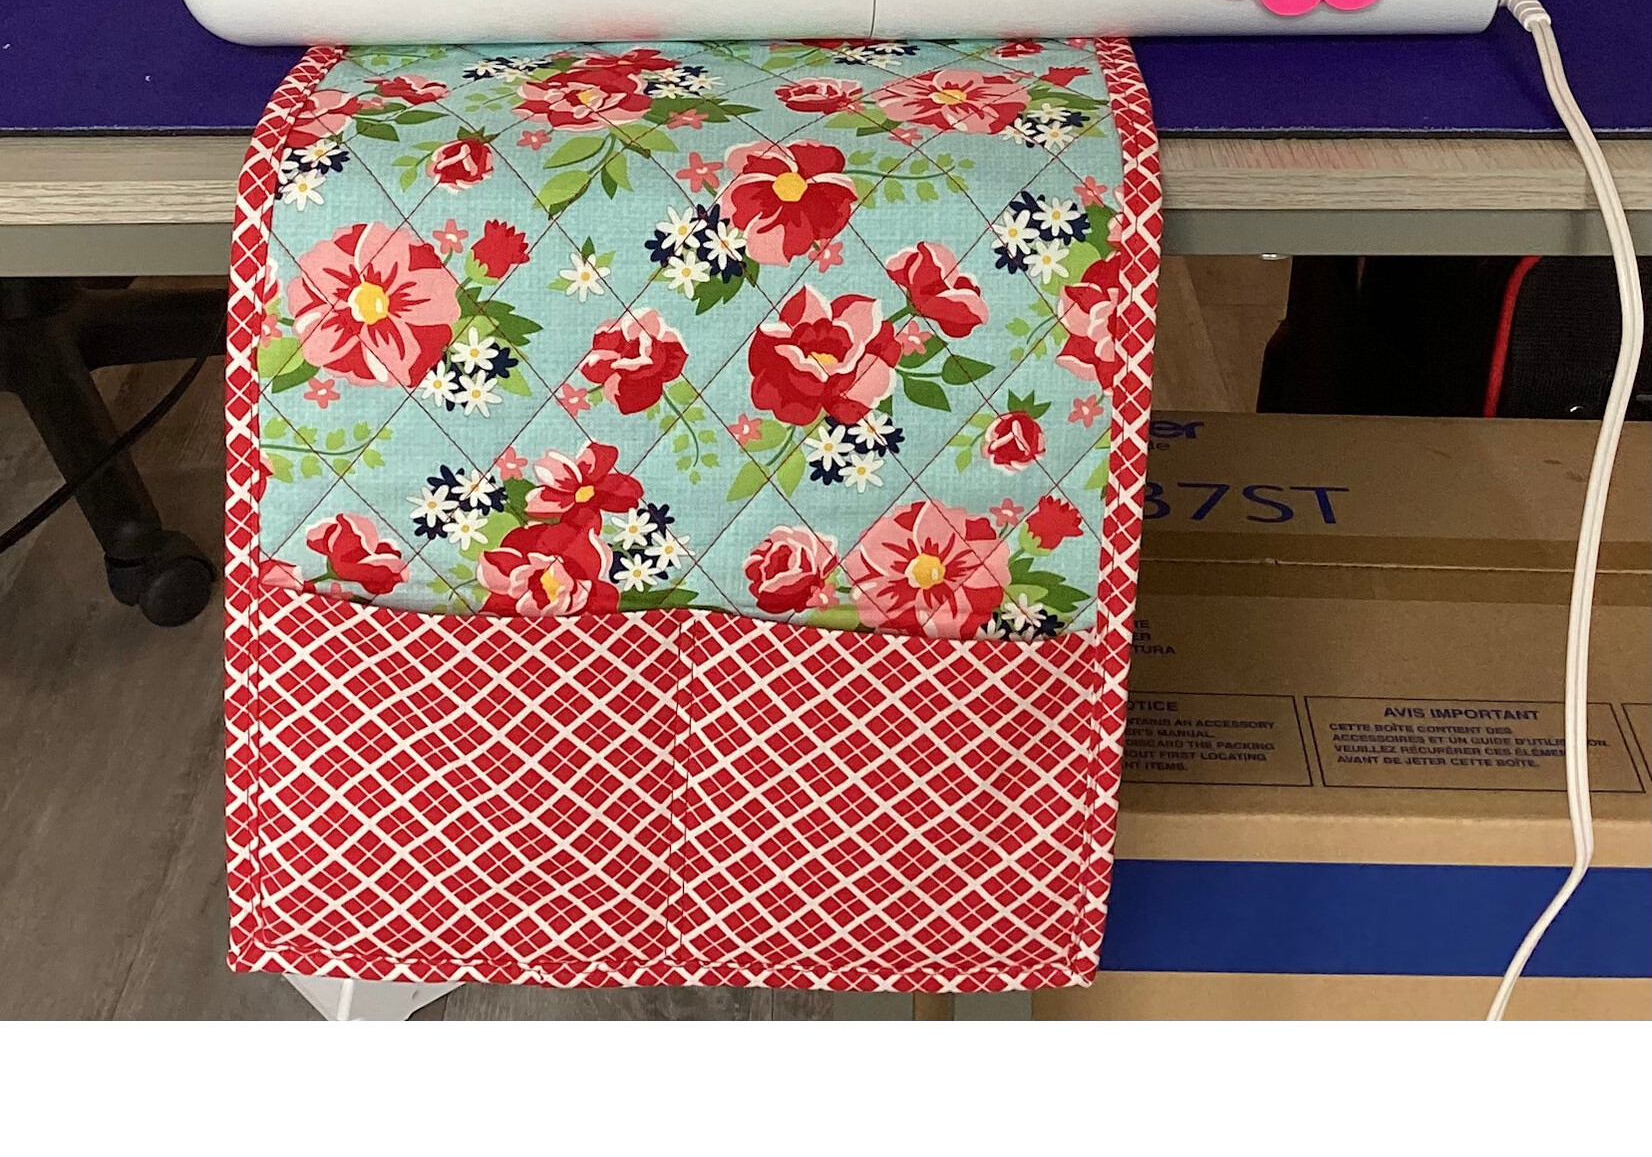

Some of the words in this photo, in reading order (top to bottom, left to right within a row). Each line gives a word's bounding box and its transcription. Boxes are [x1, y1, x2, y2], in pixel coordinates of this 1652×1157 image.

[1384, 707, 1425, 719] AVIS
[1431, 708, 1540, 720] IMPORTANT
[1195, 720, 1275, 729] ACCESSORY
[1329, 723, 1371, 732] CETTE
[1417, 725, 1482, 734] CONTIENT
[1486, 726, 1512, 735] DES
[1332, 734, 1425, 744] ACCESSOIRES
[1428, 736, 1443, 744] ET
[1449, 736, 1467, 745] UN
[1471, 737, 1510, 746] GUIDE
[1217, 742, 1276, 751] PACKING
[1335, 745, 1396, 754] VEUILLEZ
[1485, 748, 1511, 756] CES
[1159, 751, 1196, 759] FIRST
[1200, 753, 1268, 762] LOCATING
[1337, 756, 1379, 764] AVANT
[1383, 757, 1403, 765] DE
[1405, 757, 1446, 765] JETER
[1451, 758, 1492, 766] CETTE
